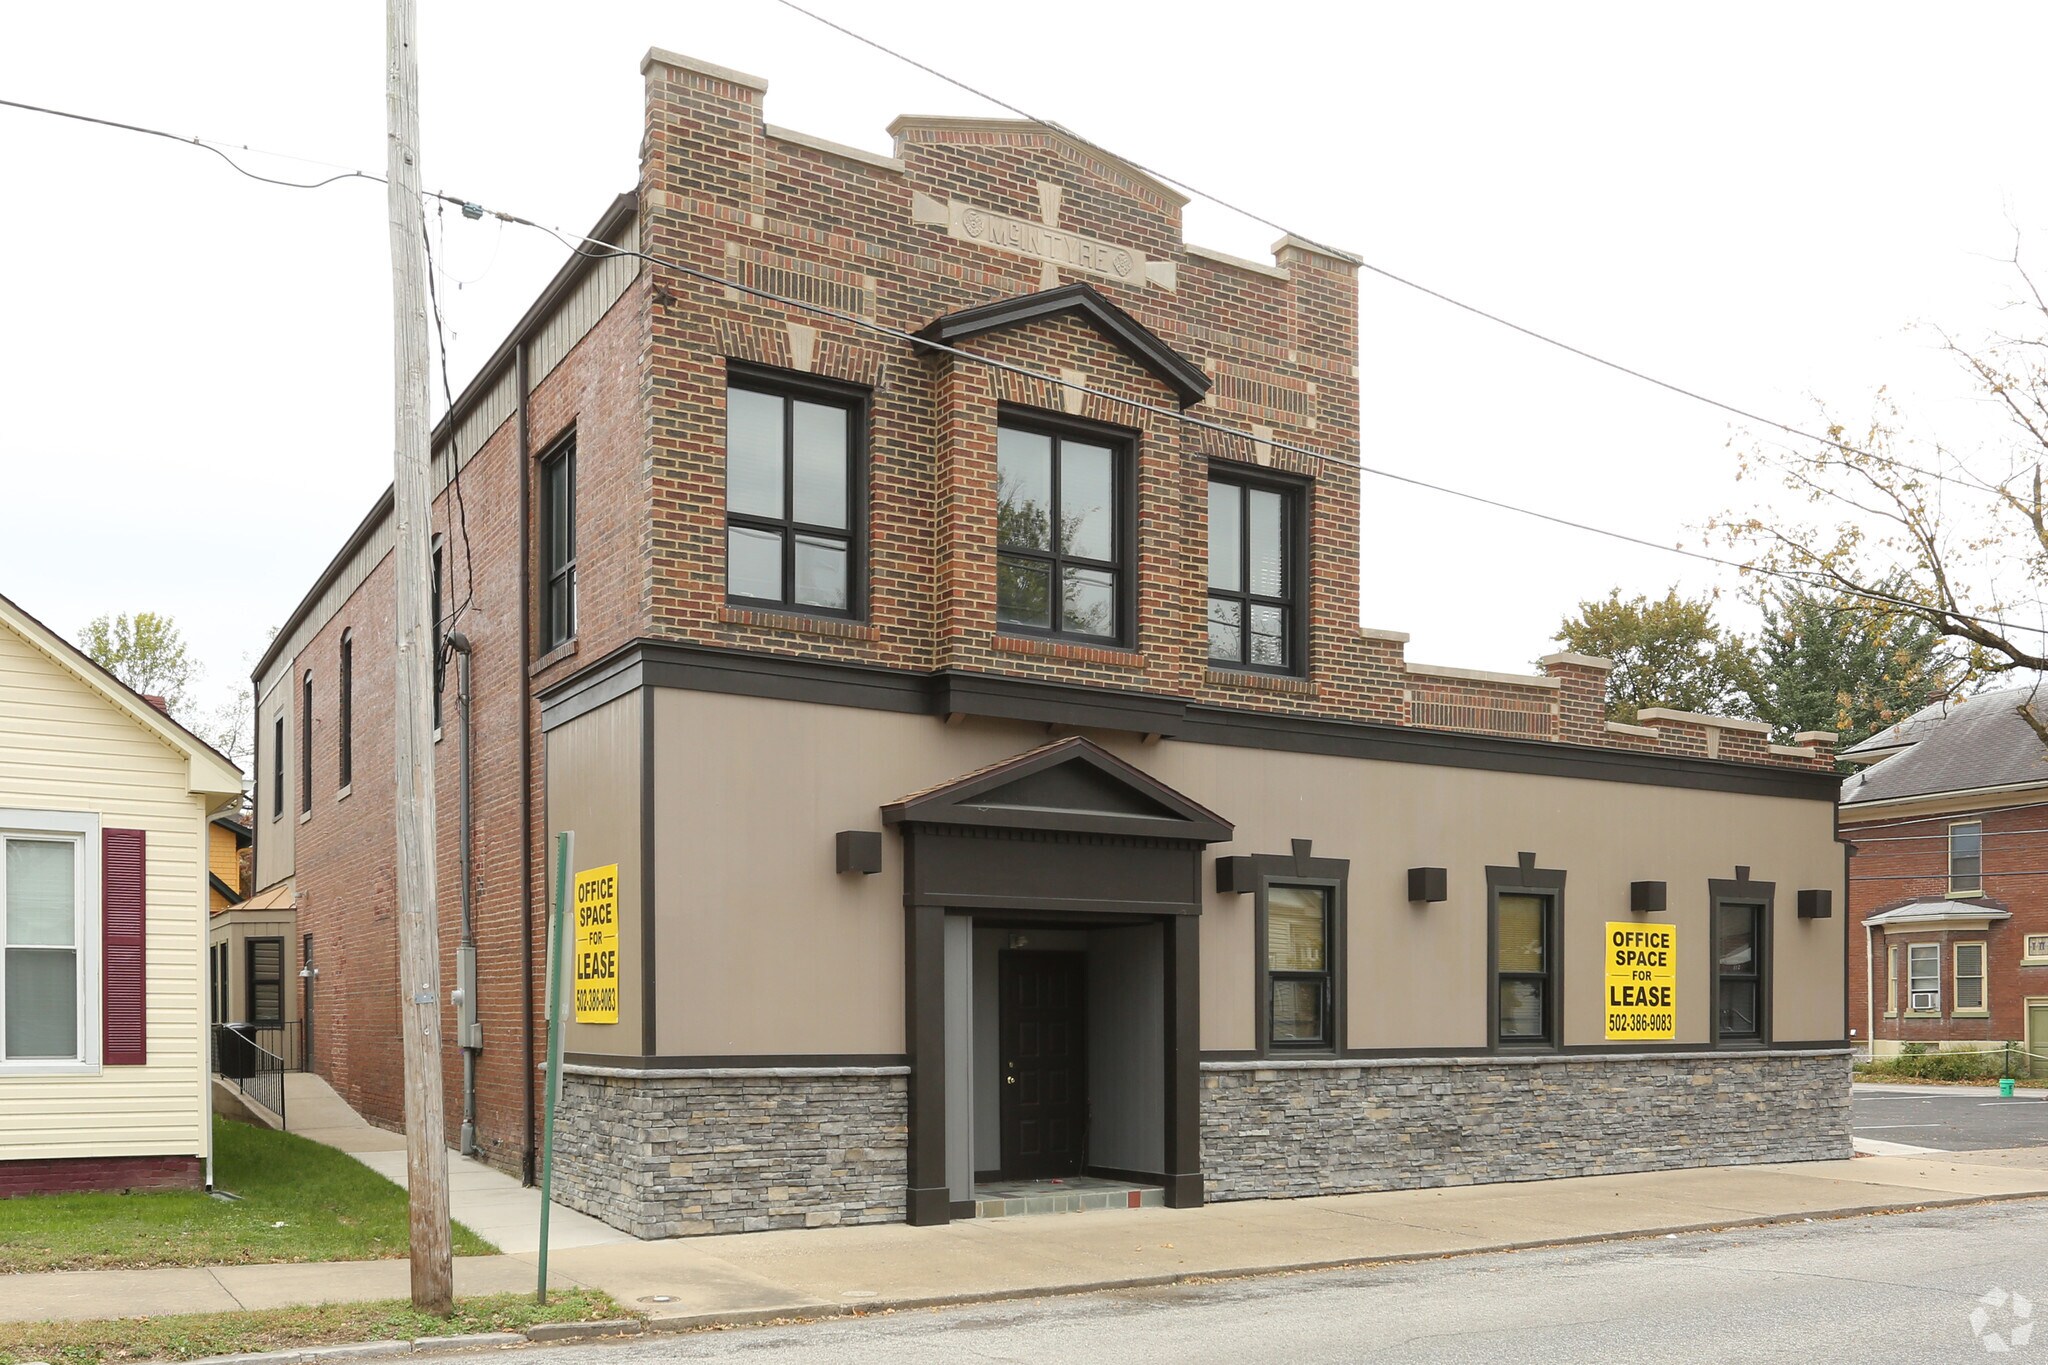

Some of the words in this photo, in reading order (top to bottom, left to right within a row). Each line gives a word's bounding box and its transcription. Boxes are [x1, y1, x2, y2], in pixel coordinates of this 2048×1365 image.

[578, 877, 613, 903] OFFICE
[579, 903, 612, 927] SPACE
[589, 931, 603, 945] FOR
[1613, 931, 1669, 948] OFFICE
[577, 951, 615, 980] LEASE
[1616, 950, 1667, 967] SPACE
[1632, 971, 1652, 981] FOR
[577, 988, 615, 1012] 502-386-9083
[1610, 986, 1671, 1007] LEASE
[1609, 1014, 1672, 1031] 502-386-9083
